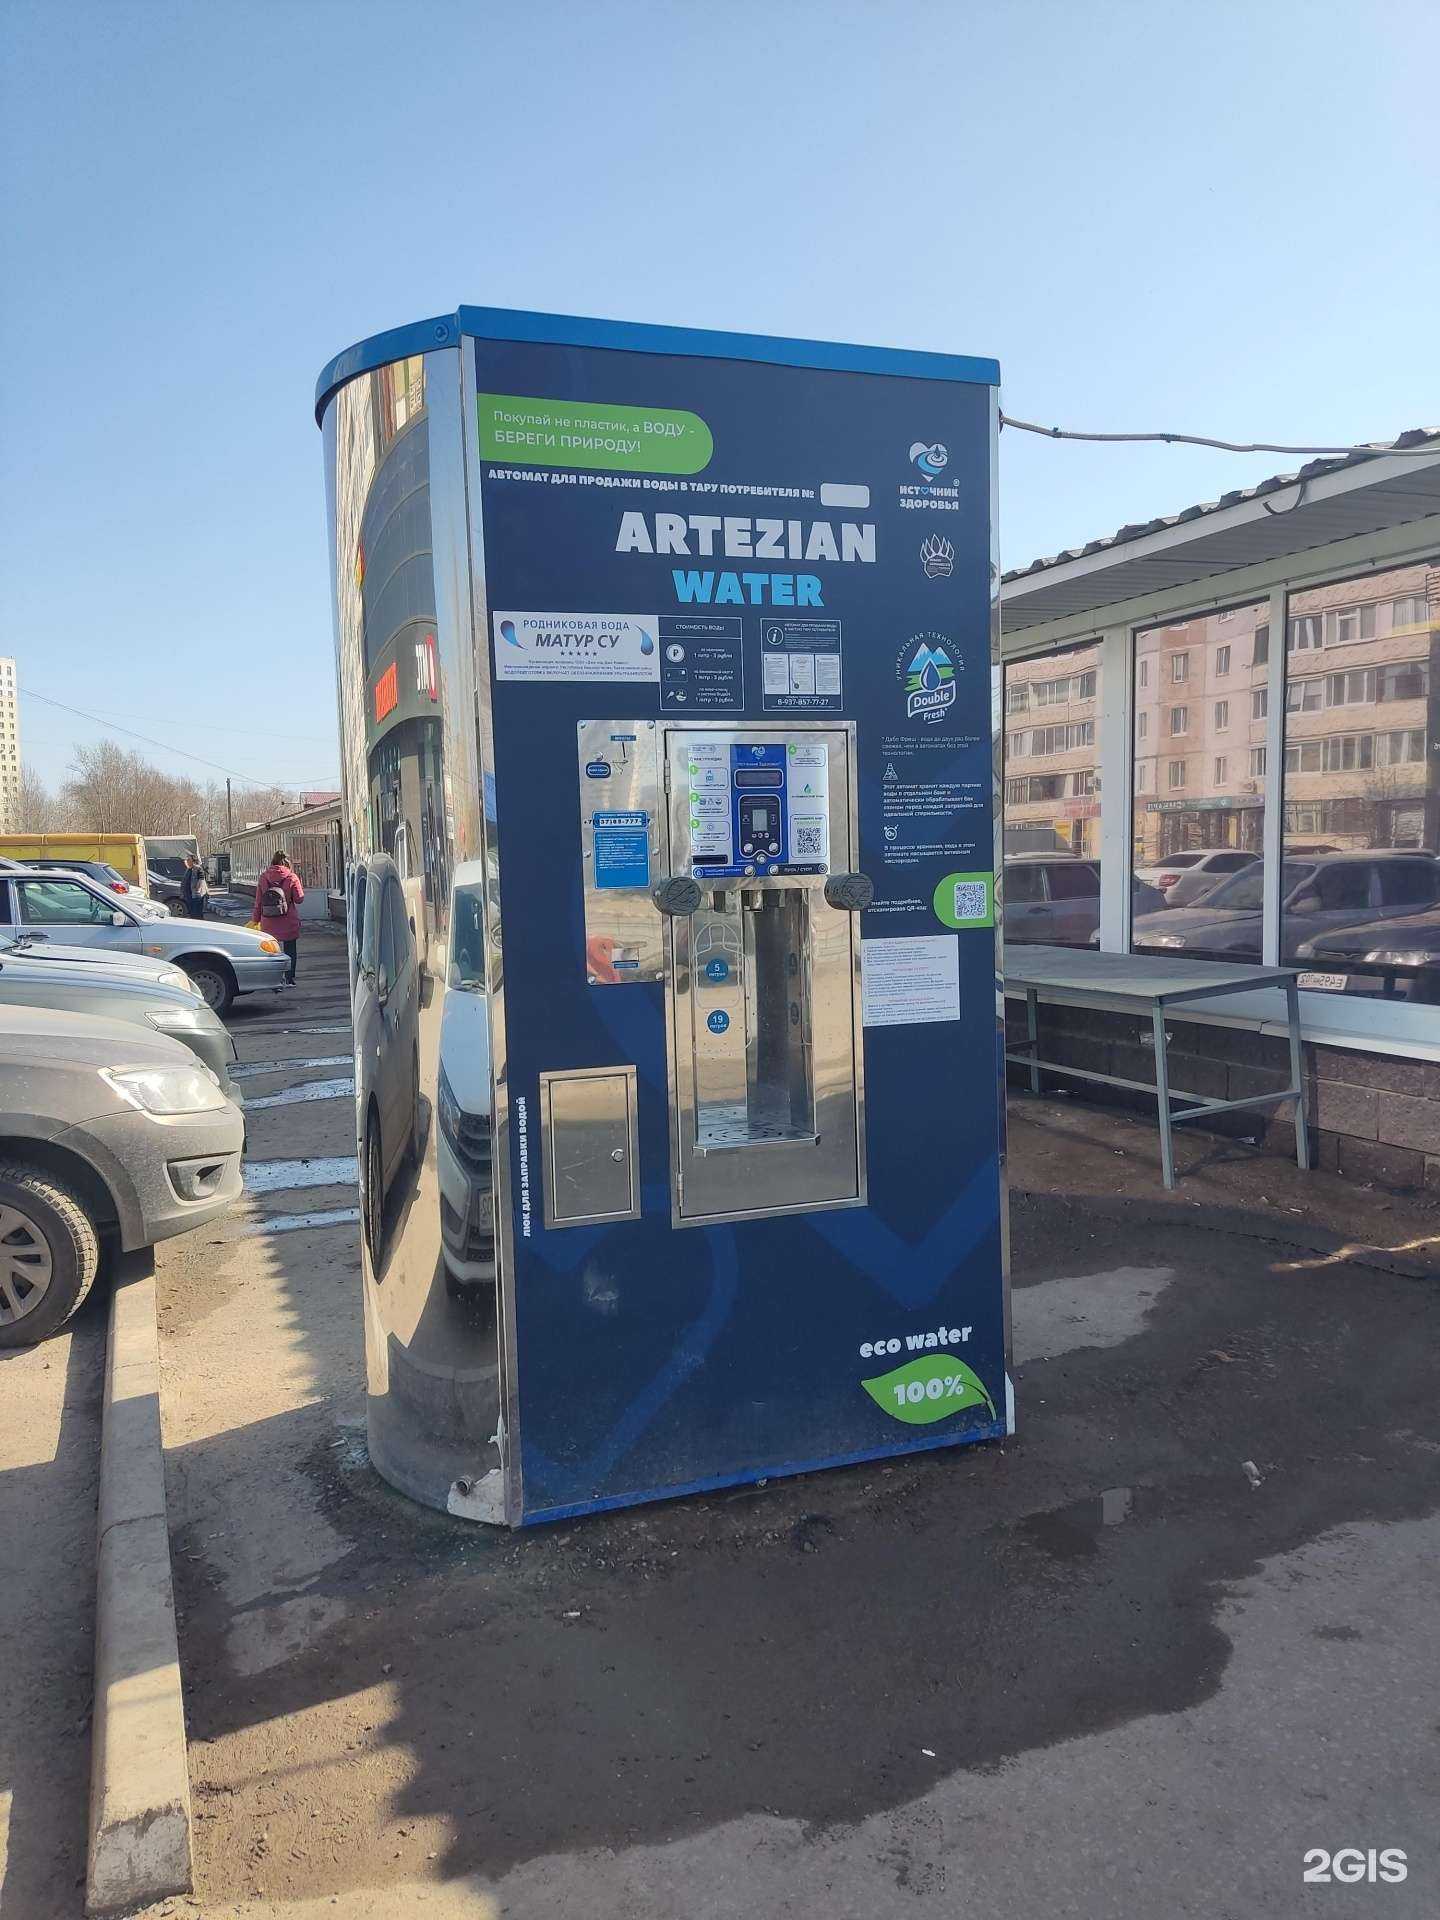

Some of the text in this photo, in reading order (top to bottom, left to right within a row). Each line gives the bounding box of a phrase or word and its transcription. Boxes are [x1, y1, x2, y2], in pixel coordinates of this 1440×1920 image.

[494, 410, 550, 426] Покупай
[554, 415, 571, 428] не
[574, 418, 630, 433] пластик,
[632, 424, 640, 433] а
[643, 421, 685, 437] ВОДУ
[495, 430, 641, 453] БЕРЕГИ ПРИРОДУ!
[488, 469, 815, 499] АВТОМАТ ДЛЯ ПРОДАЖИ ВОДЫ В ТАРУ ПОТРЕБИТЕЛЯ №
[899, 498, 959, 510] ЗДОРОВЬЯ
[615, 511, 876, 563] ARTEZIAN
[672, 569, 825, 607] WATER
[523, 619, 630, 631] РОДНИКОВАЯ ВОДА
[895, 631, 965, 680] УНИКАЛЬНАЯ ТЕХНОЛОГИЯ
[913, 691, 950, 708] Double
[712, 1015, 724, 1024] 19
[516, 1096, 531, 1237] ЛЮК ДЛЯ ЗАПРАВКИ ВОДОЙ
[859, 1325, 972, 1358] eco water
[894, 1374, 964, 1405] 100%
